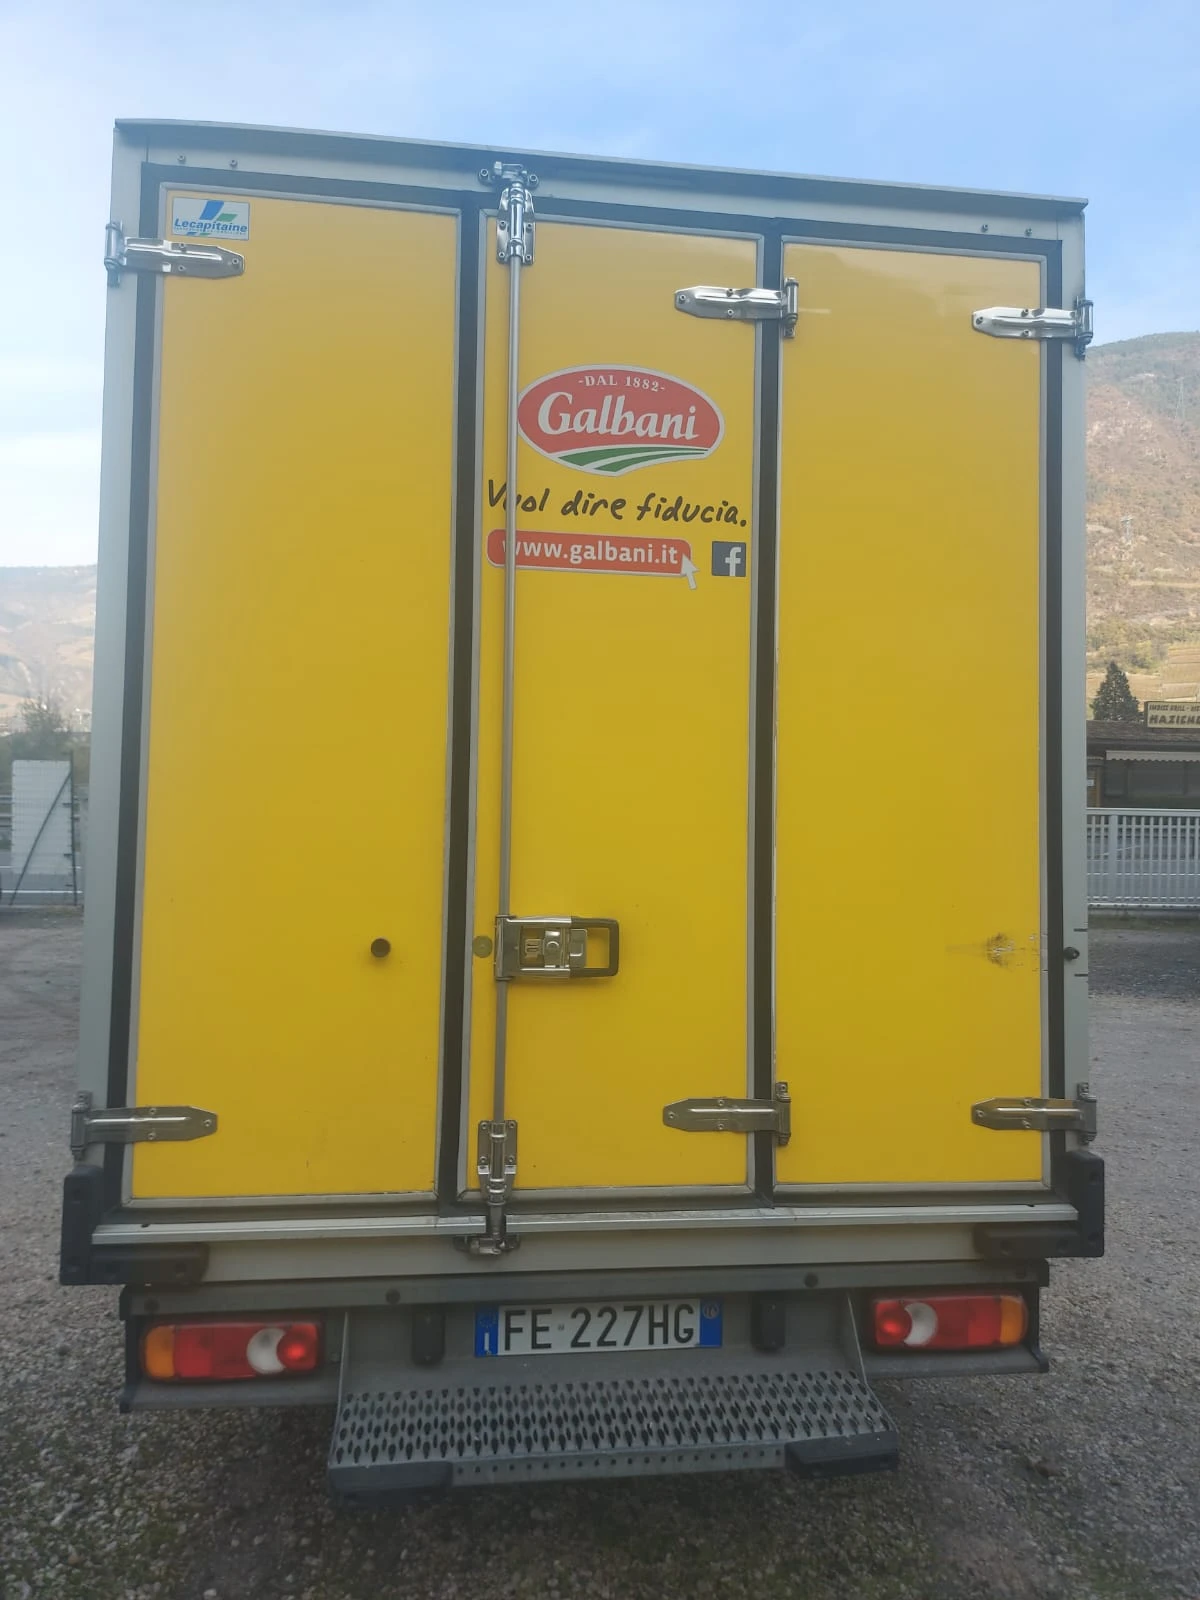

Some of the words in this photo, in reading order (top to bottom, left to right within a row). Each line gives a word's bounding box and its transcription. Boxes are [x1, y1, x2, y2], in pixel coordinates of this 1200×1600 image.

[174, 218, 248, 233] Lecapitaine
[538, 391, 700, 441] Galbani
[560, 490, 627, 520] dire
[637, 492, 748, 528] fiducia.
[504, 1308, 553, 1351] FE
[570, 1303, 695, 1348] 227HG
